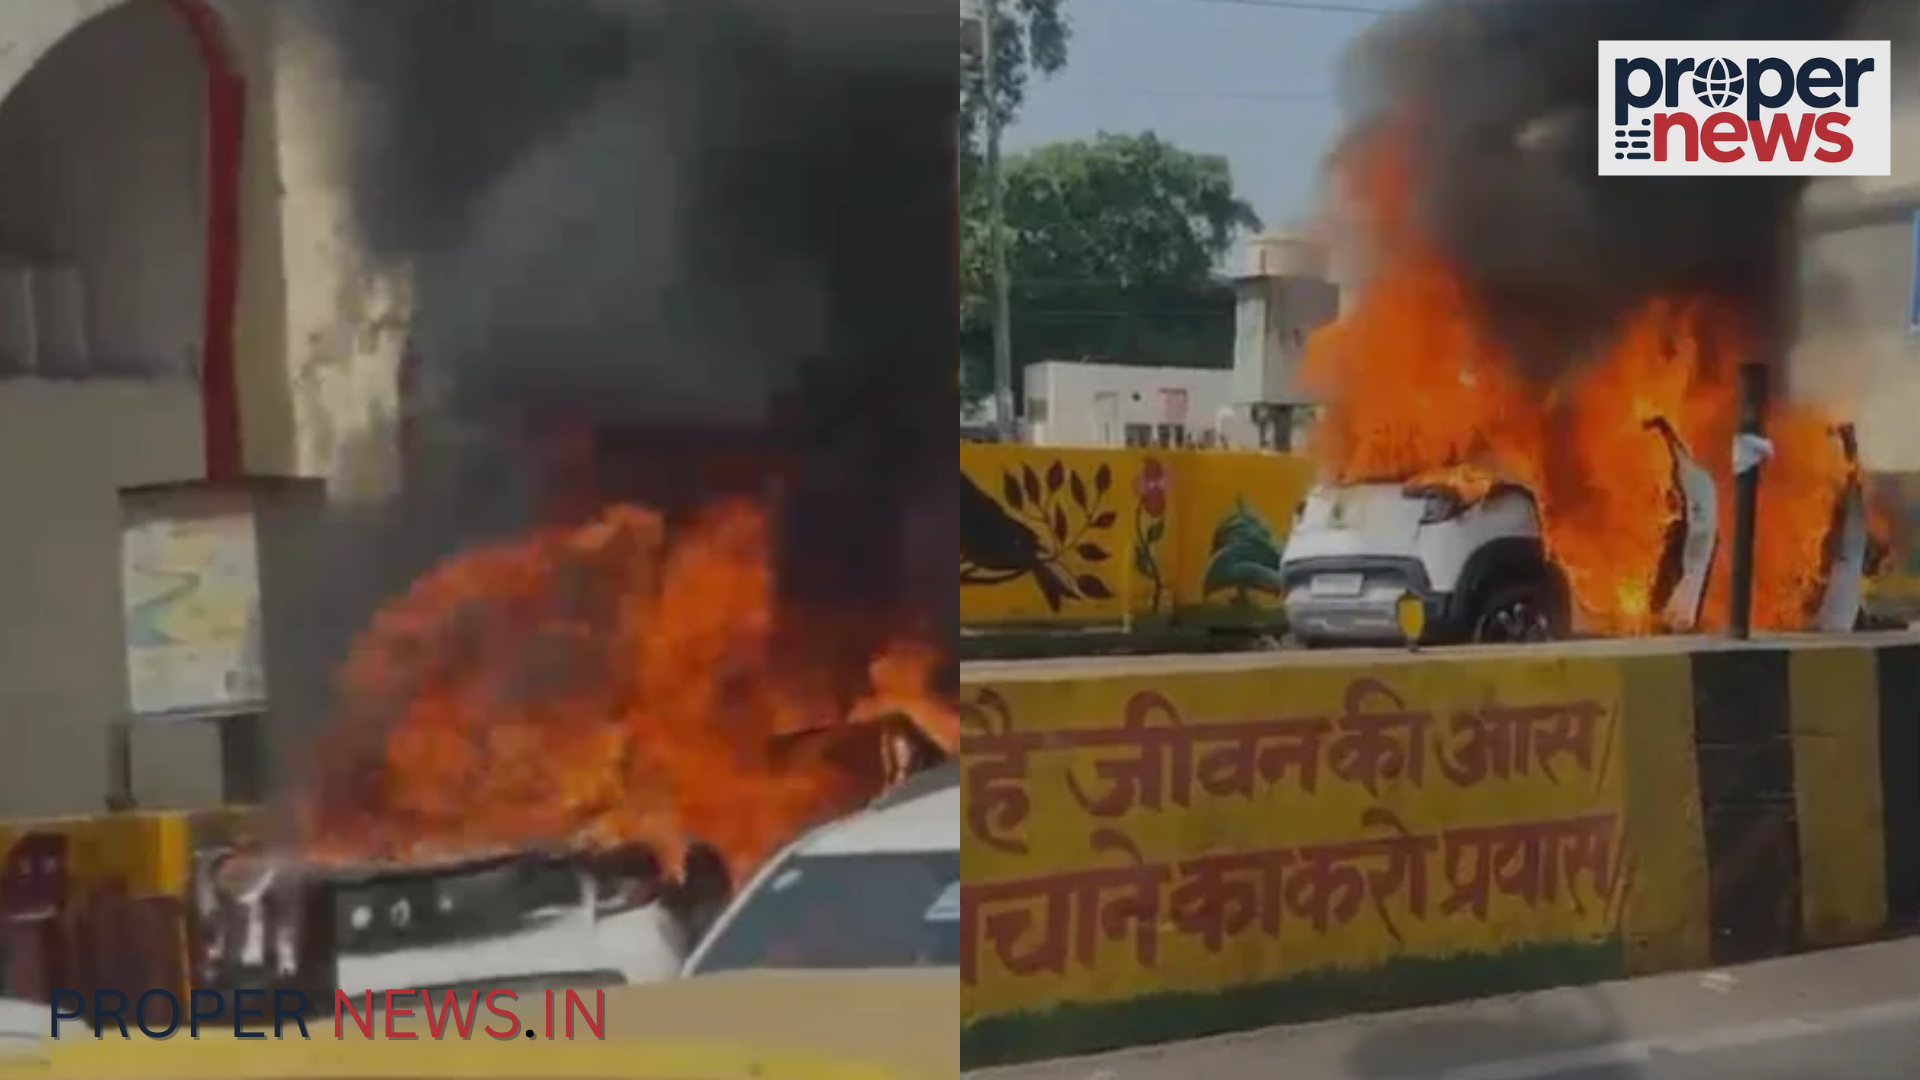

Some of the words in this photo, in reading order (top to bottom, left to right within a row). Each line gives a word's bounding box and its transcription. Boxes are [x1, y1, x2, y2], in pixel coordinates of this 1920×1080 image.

[1052, 690, 1334, 809] जीवन
[1328, 677, 1435, 798] की
[1166, 847, 1298, 953] का
[1284, 807, 1440, 944] करो
